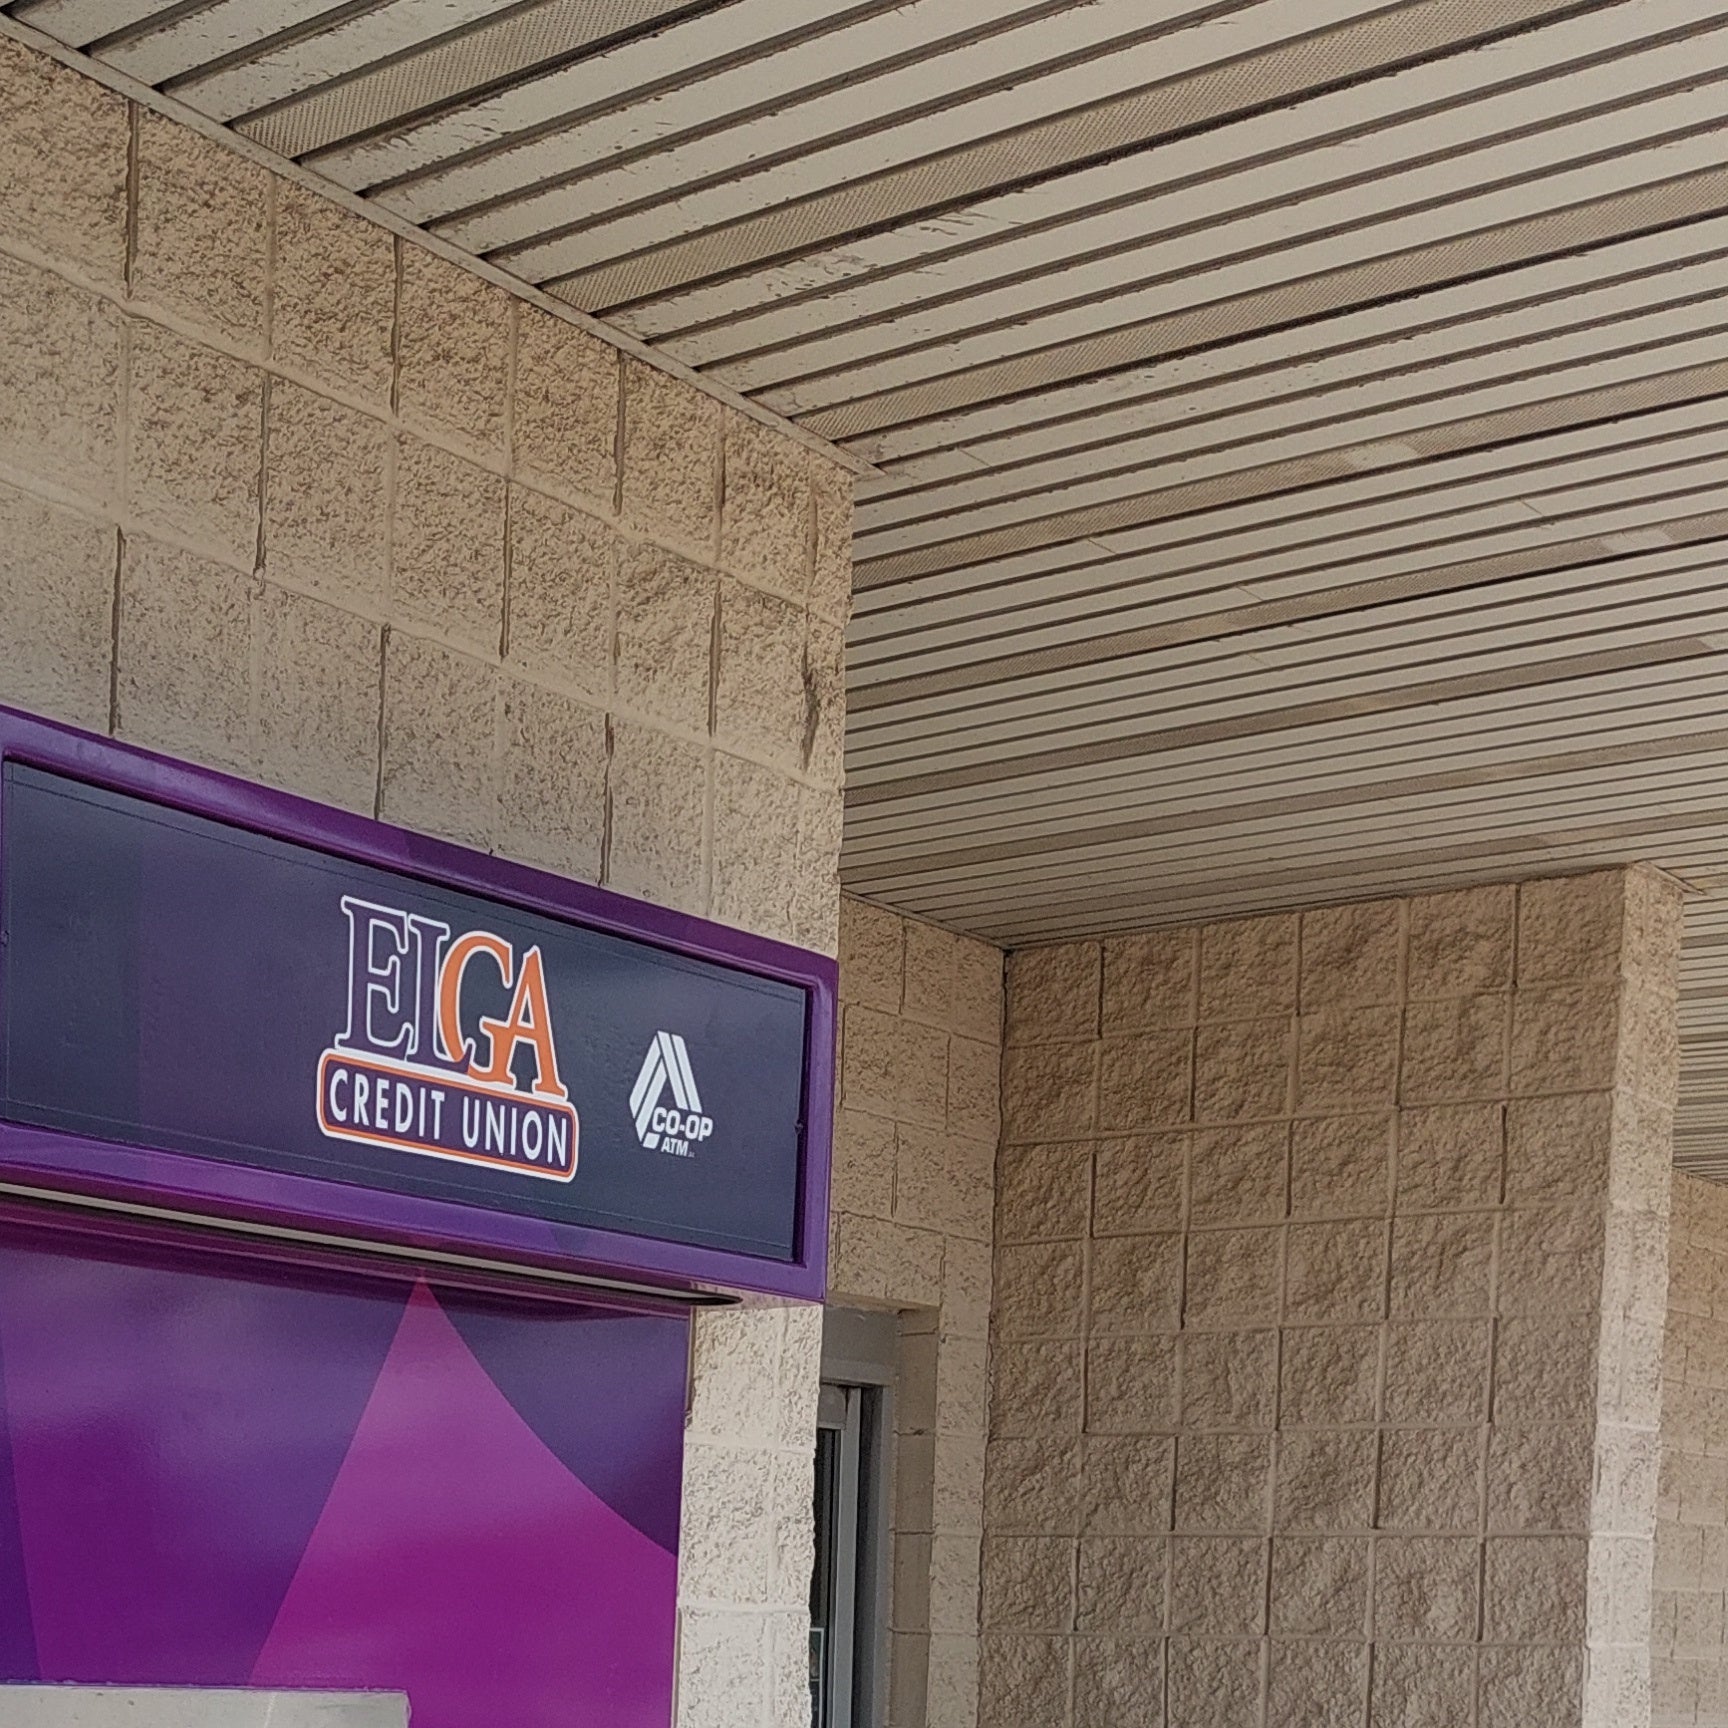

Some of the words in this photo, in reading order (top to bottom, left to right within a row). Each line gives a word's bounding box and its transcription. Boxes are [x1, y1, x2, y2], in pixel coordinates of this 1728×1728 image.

[335, 895, 568, 1102] ELGA
[328, 1066, 446, 1141] CREDIT
[461, 1094, 569, 1168] UNION
[651, 1106, 714, 1142] CO-OP
[660, 1136, 690, 1157] ATM
